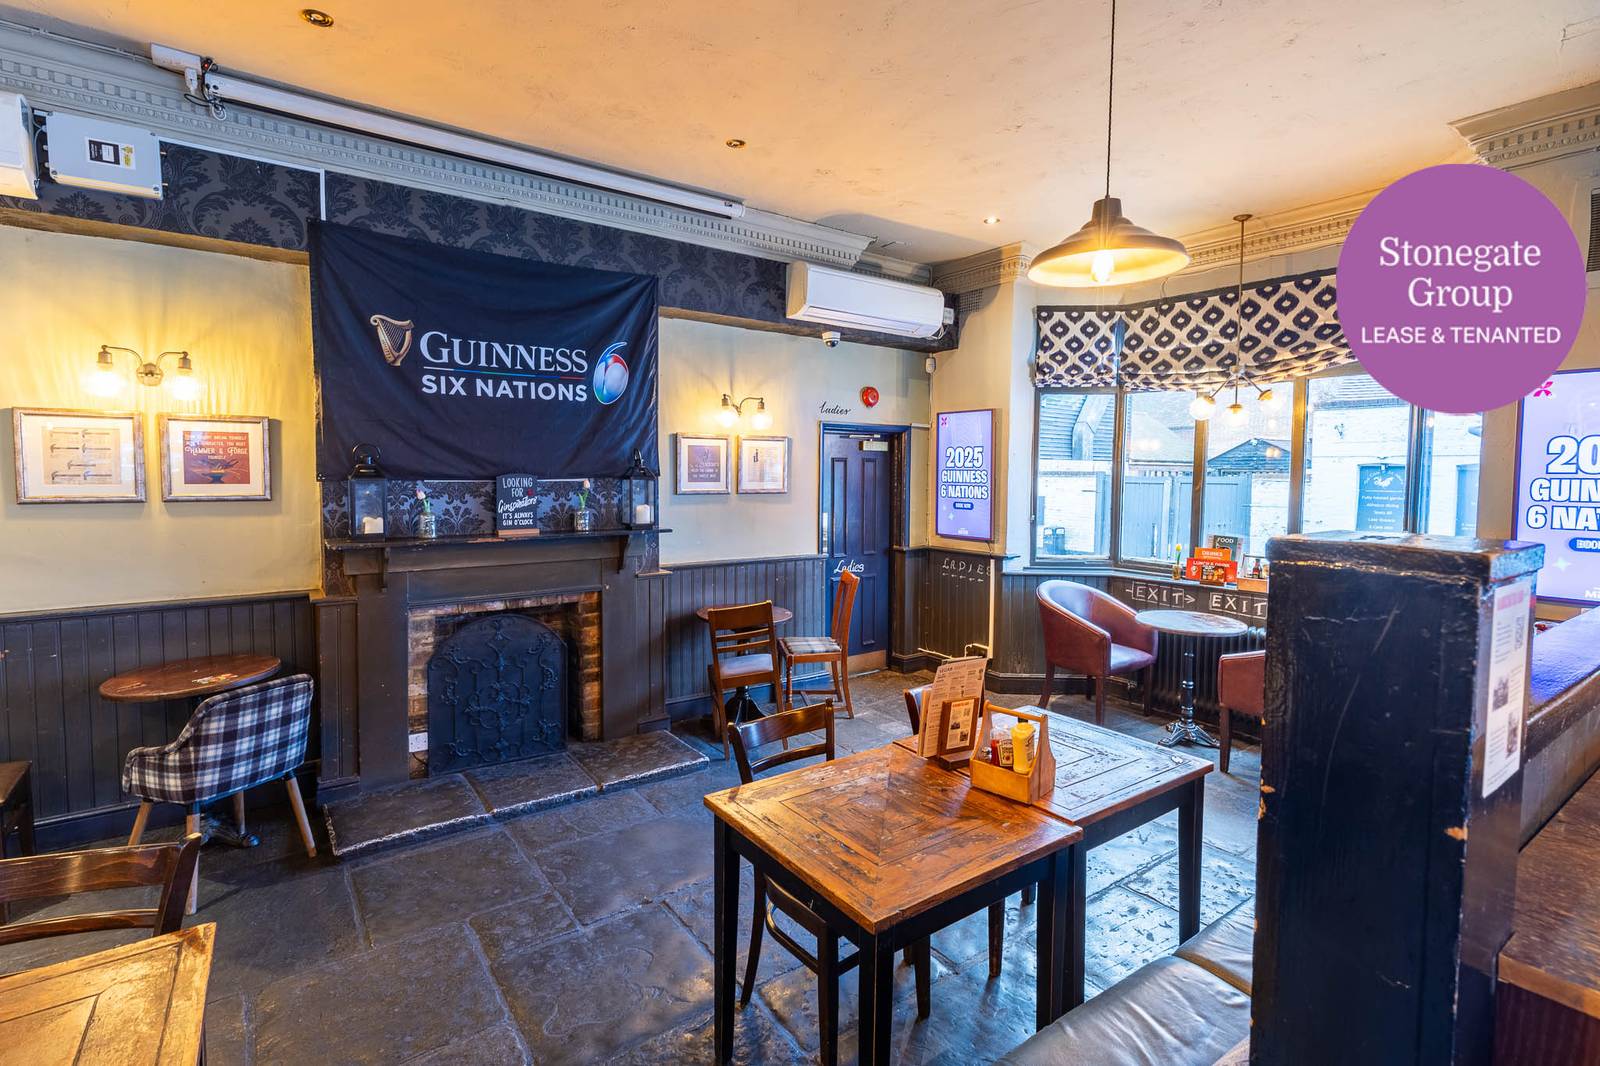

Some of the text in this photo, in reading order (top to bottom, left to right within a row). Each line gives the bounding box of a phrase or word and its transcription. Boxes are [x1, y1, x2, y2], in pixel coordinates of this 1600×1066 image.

[419, 331, 588, 374] GUINNESS
[421, 374, 588, 402] SIX NATIONS
[946, 446, 984, 468] 2025
[502, 477, 533, 488] LOOKING
[941, 469, 988, 484] GUINNESS
[511, 487, 523, 497] FOR
[940, 484, 988, 499] 6 NATIONS
[1527, 505, 1547, 529] 6
[1136, 585, 1267, 616] EXIT EXIT
